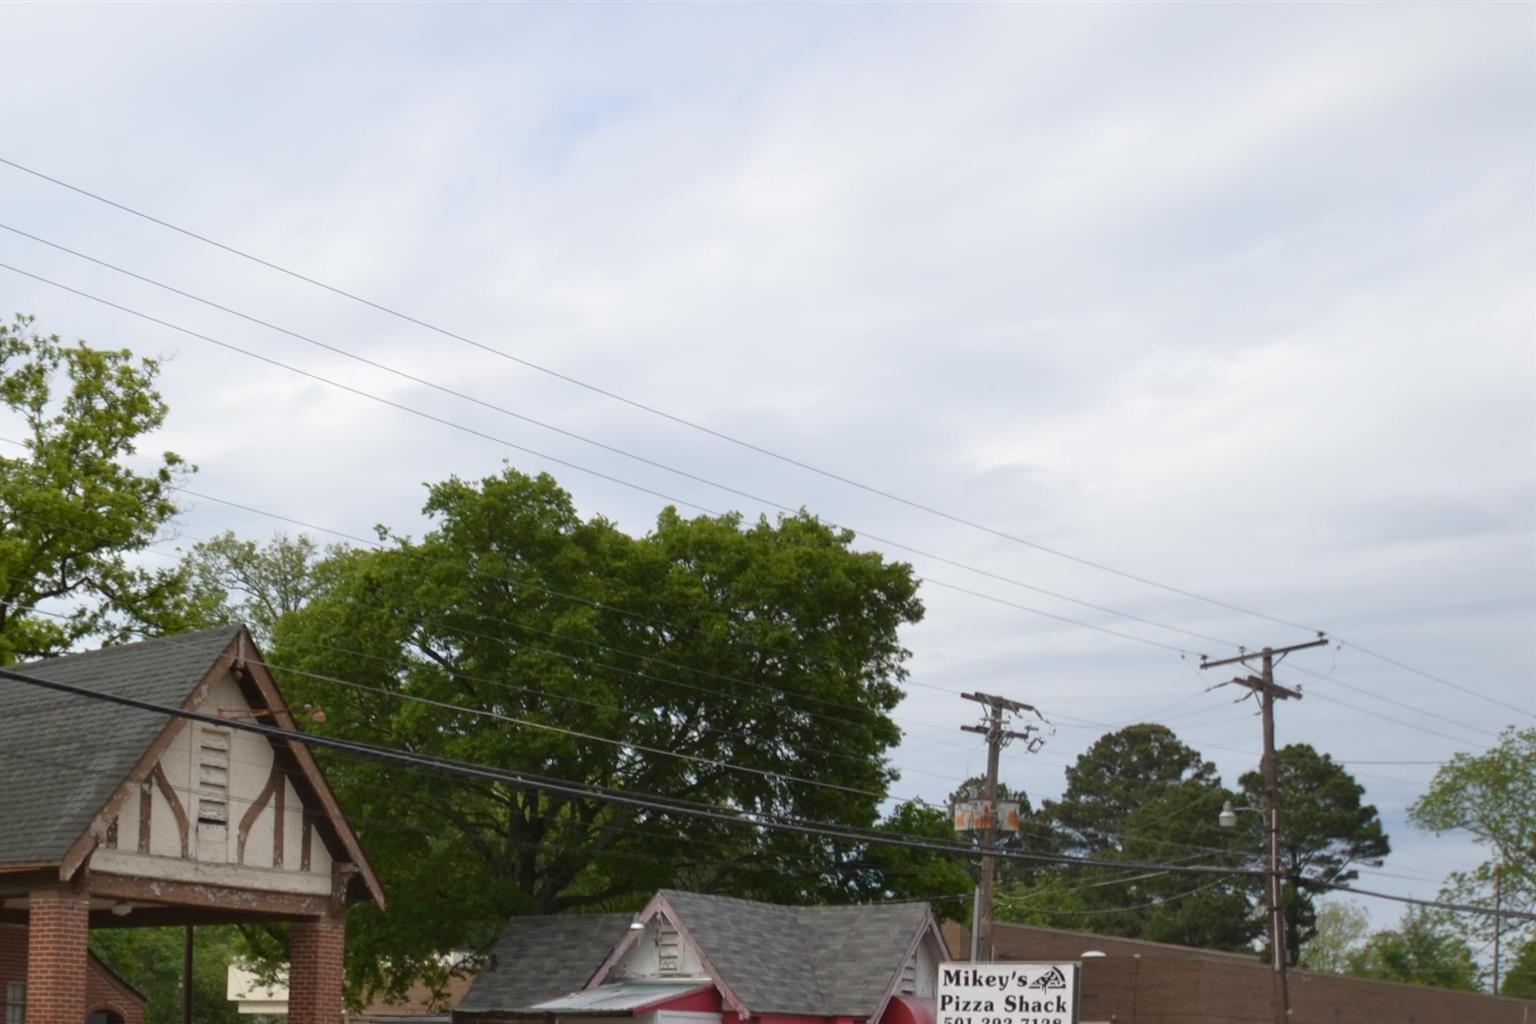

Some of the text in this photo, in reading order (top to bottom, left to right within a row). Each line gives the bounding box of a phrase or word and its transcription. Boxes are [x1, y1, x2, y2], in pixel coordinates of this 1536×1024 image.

[943, 969, 1028, 991] Mikey's
[940, 994, 1067, 1013] Pizza Shack
